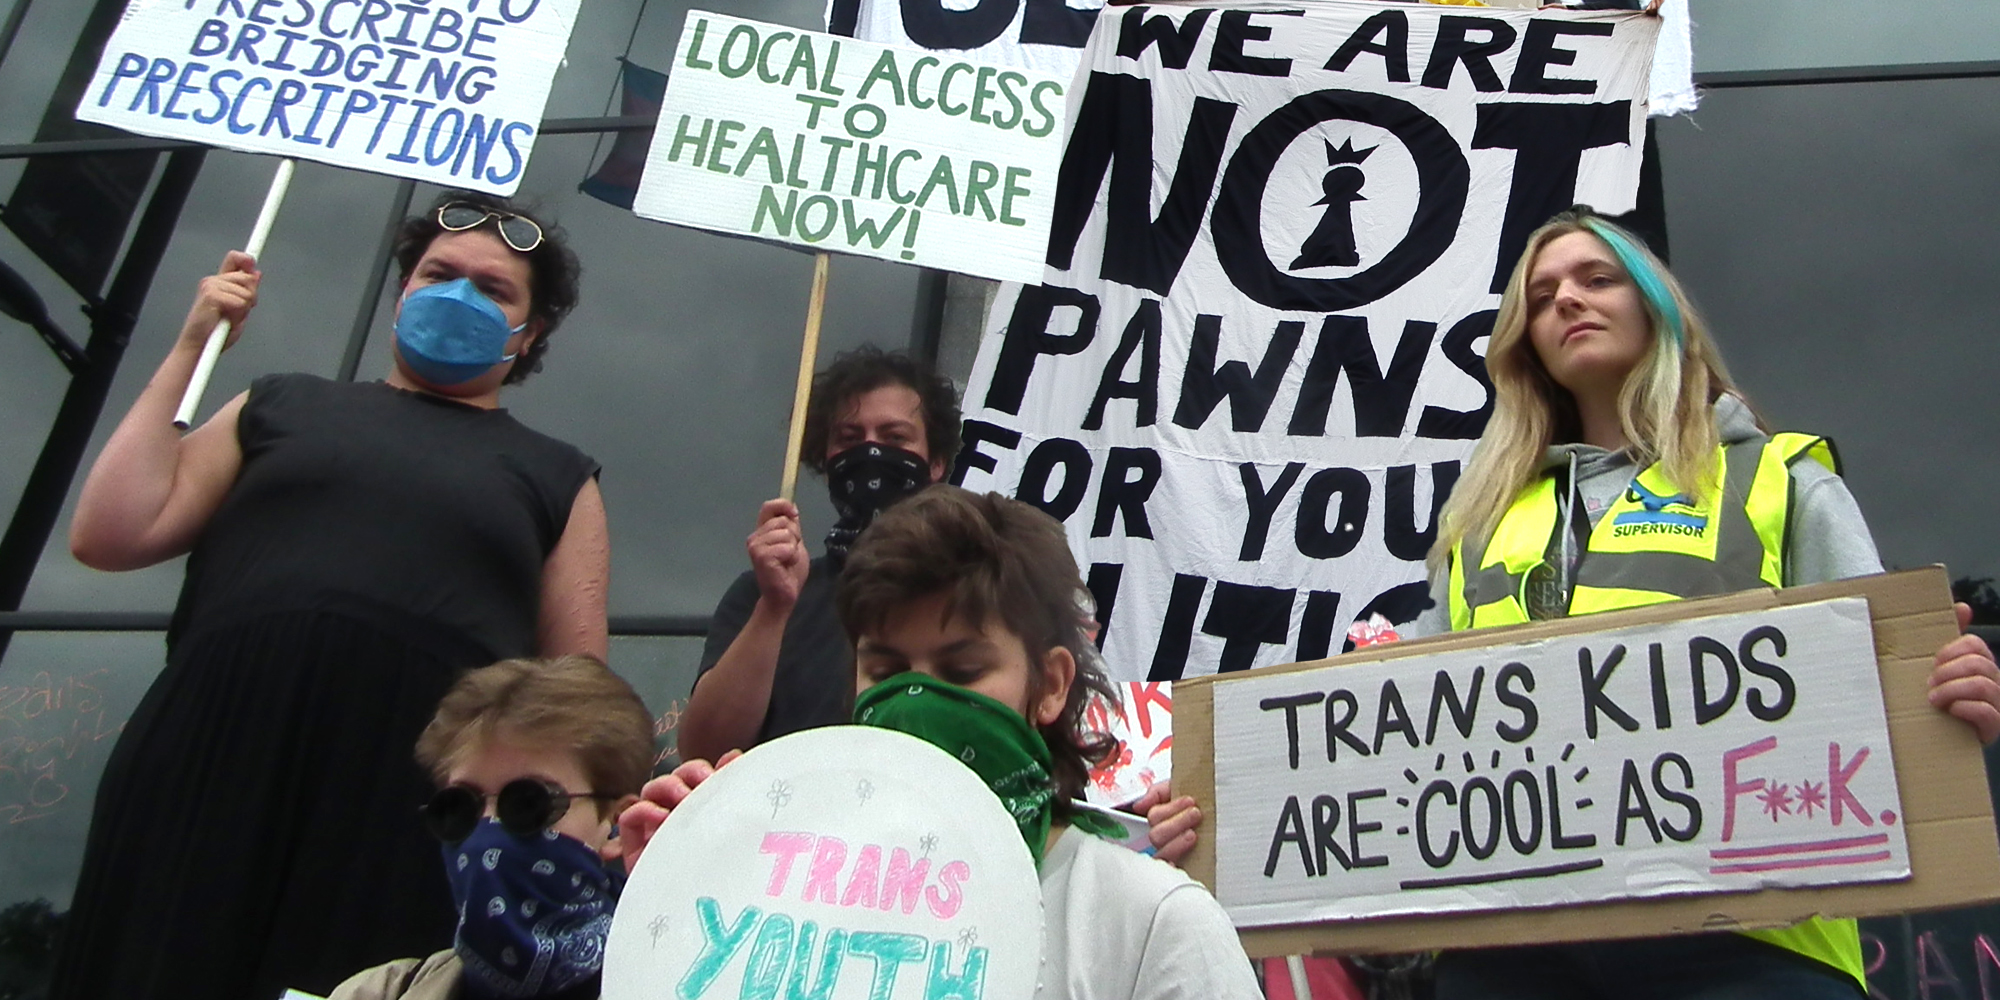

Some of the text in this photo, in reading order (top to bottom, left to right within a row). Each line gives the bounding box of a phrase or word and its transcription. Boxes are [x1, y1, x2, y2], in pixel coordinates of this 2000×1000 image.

[186, 0, 504, 60] ESCRIBE
[190, 18, 498, 104] BRIDGING
[685, 18, 845, 96] LOCAL
[856, 48, 1064, 138] ACCESS
[1115, 4, 1306, 77] WE
[1322, 9, 1615, 95] ARE
[98, 52, 533, 185] PRESCRIPTIONS
[796, 93, 887, 139] TO
[667, 114, 1032, 227] HEALTHCARE
[750, 185, 922, 260] NOW!
[1045, 70, 1631, 313] NOT
[984, 284, 1498, 439] PAWNS
[948, 418, 1162, 541] FOR
[1613, 523, 1705, 539] SUPERVISOR
[1259, 659, 1541, 770] TRANS
[1576, 623, 1797, 740] KIDS
[1263, 787, 1389, 878] ARE
[1414, 763, 1597, 869] COOL
[1614, 751, 1703, 847] AS
[759, 831, 971, 921] TRANS
[675, 896, 990, 1000] YOUTH
